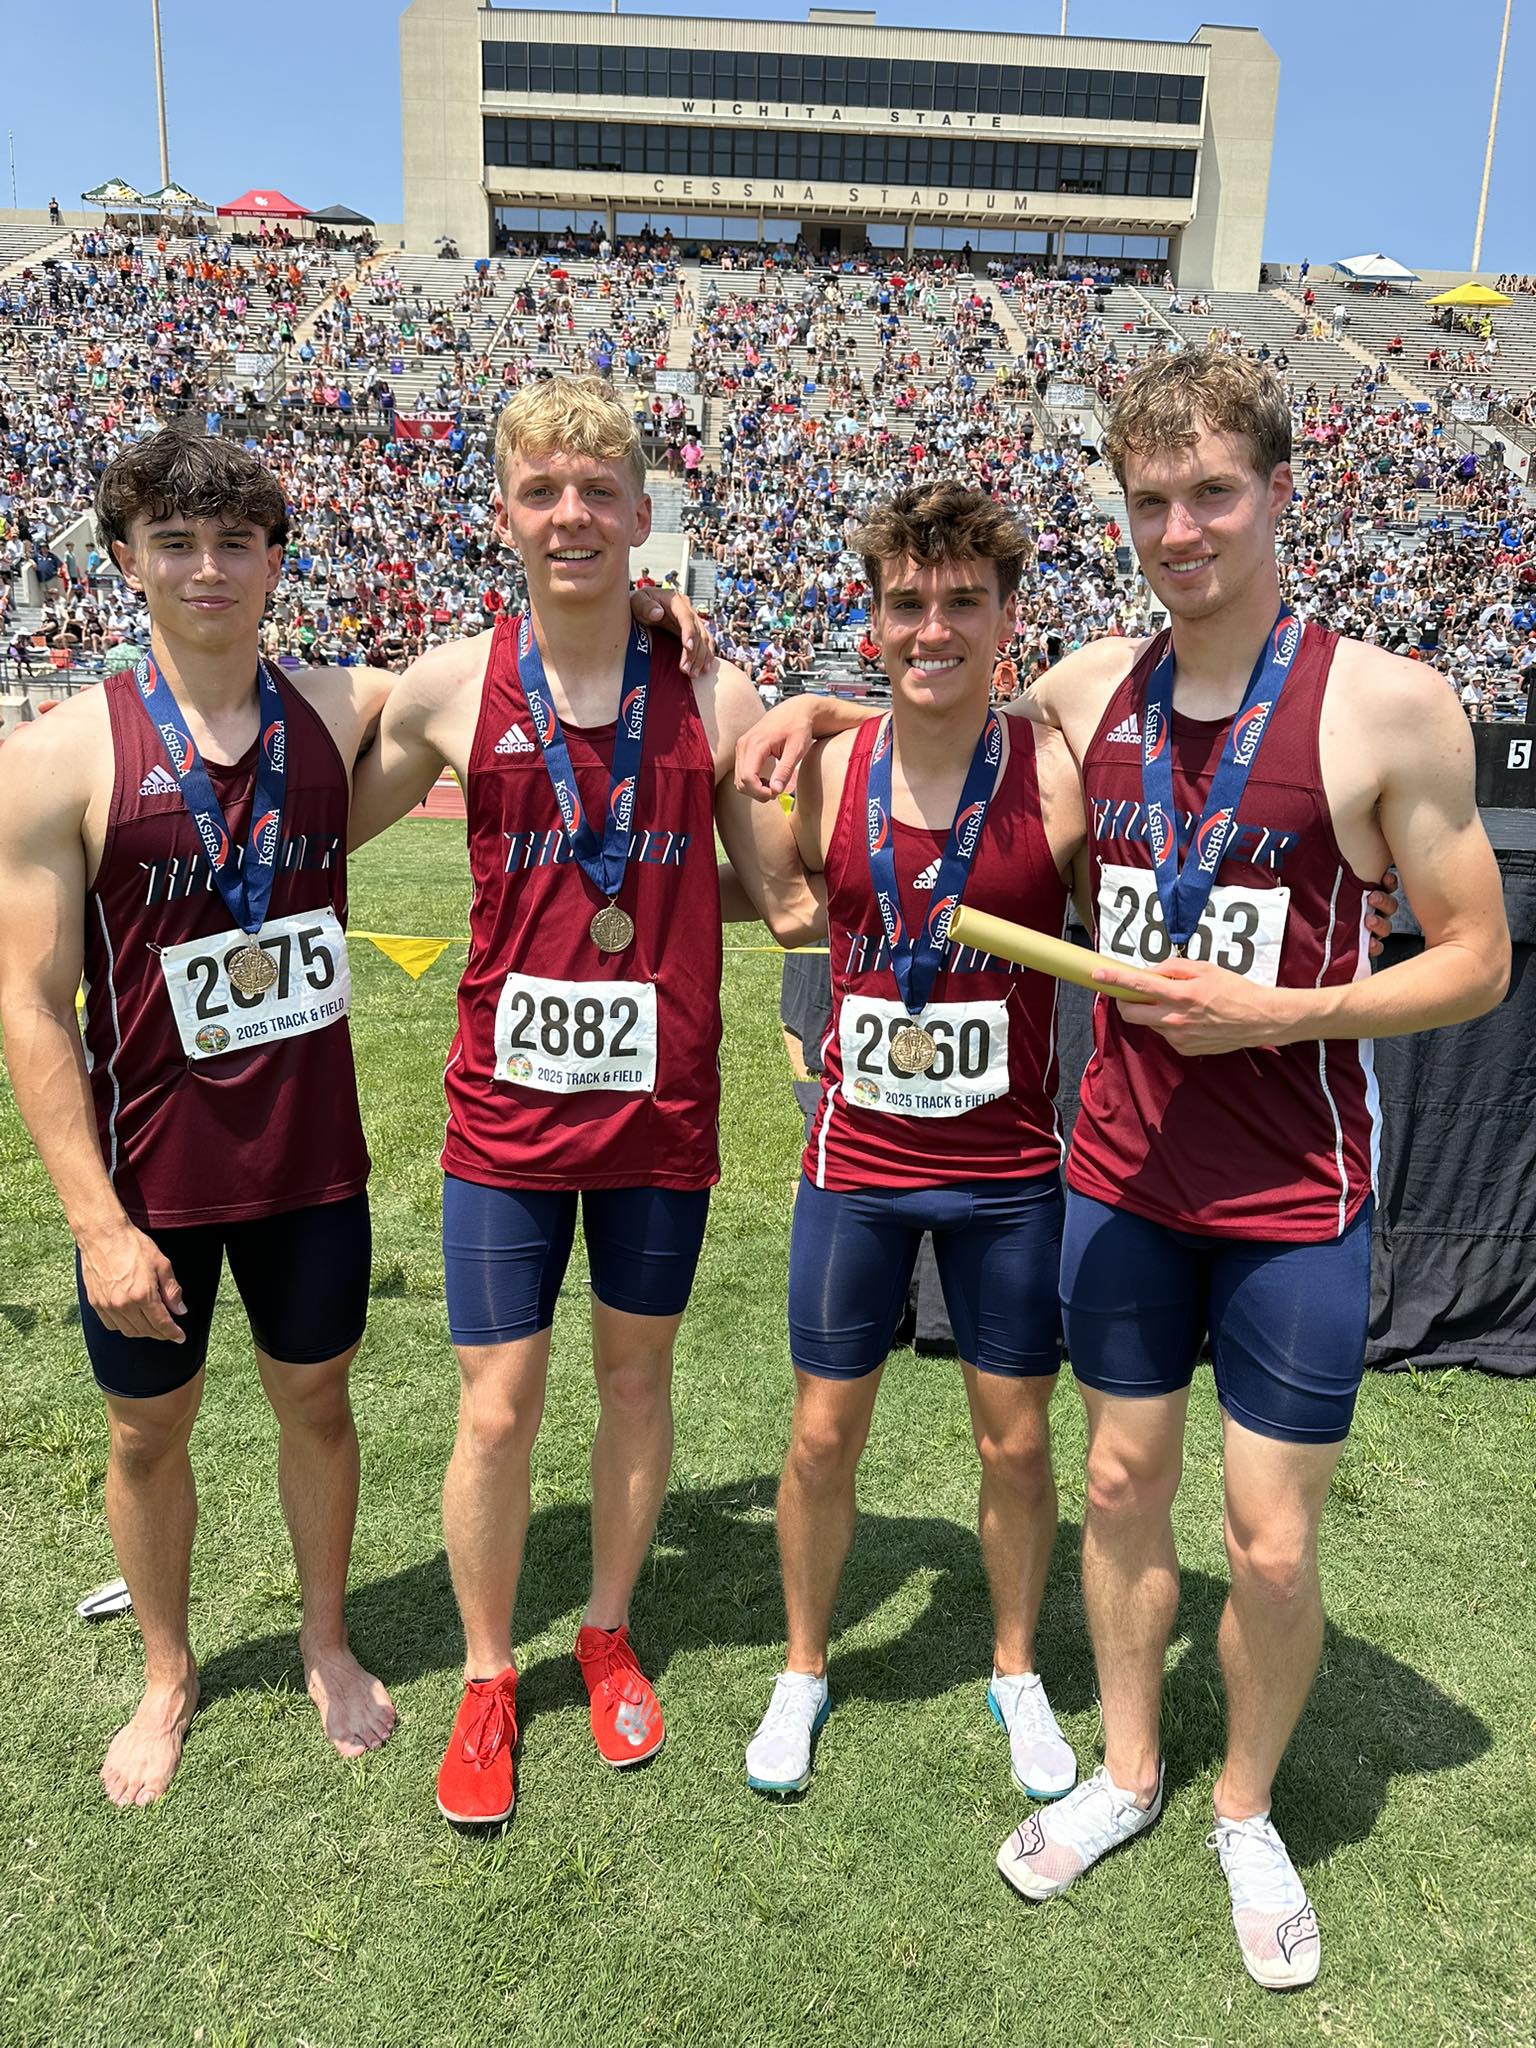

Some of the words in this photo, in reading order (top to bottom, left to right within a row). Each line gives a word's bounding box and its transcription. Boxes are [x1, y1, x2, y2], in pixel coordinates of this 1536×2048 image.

[682, 101, 842, 121] WICHITA
[890, 112, 1001, 128] STATE
[653, 180, 814, 200] CESSNA
[849, 188, 1029, 210] STADIUM
[527, 689, 552, 748] KSHSAA
[628, 684, 647, 740] KSHSAA
[1106, 731, 1142, 744] adidas
[1145, 701, 1161, 765] KSHSAA
[1233, 700, 1272, 767] KSHSAA
[158, 722, 191, 778] KSHSAA
[270, 720, 284, 774] KSHSAA
[494, 741, 535, 754] adidas
[1512, 742, 1527, 767] 5
[554, 779, 577, 837] KSHSAA
[615, 775, 636, 832] KSHSAA
[868, 797, 881, 857] KSHSAA
[957, 800, 987, 859] KSHSAA
[195, 811, 225, 873] KSHSAA
[258, 808, 280, 867] KSHSAA
[1148, 801, 1167, 868] KSHSAA
[1198, 807, 1234, 874] KSHSAA
[877, 891, 899, 950] KSHSAA
[930, 894, 959, 951] KSHSAA
[236, 1022, 268, 1041] 2025
[270, 1011, 308, 1032] TRACK
[310, 1008, 319, 1021] &
[319, 997, 345, 1018] FIELD
[510, 990, 639, 1059] 2882
[537, 1067, 563, 1084] 2025
[566, 1069, 600, 1085] TRACK
[603, 1071, 610, 1082] &
[613, 1070, 642, 1082] FIELD
[885, 1092, 912, 1108] 2025
[915, 1095, 951, 1109] TRACK
[954, 1095, 962, 1108] &
